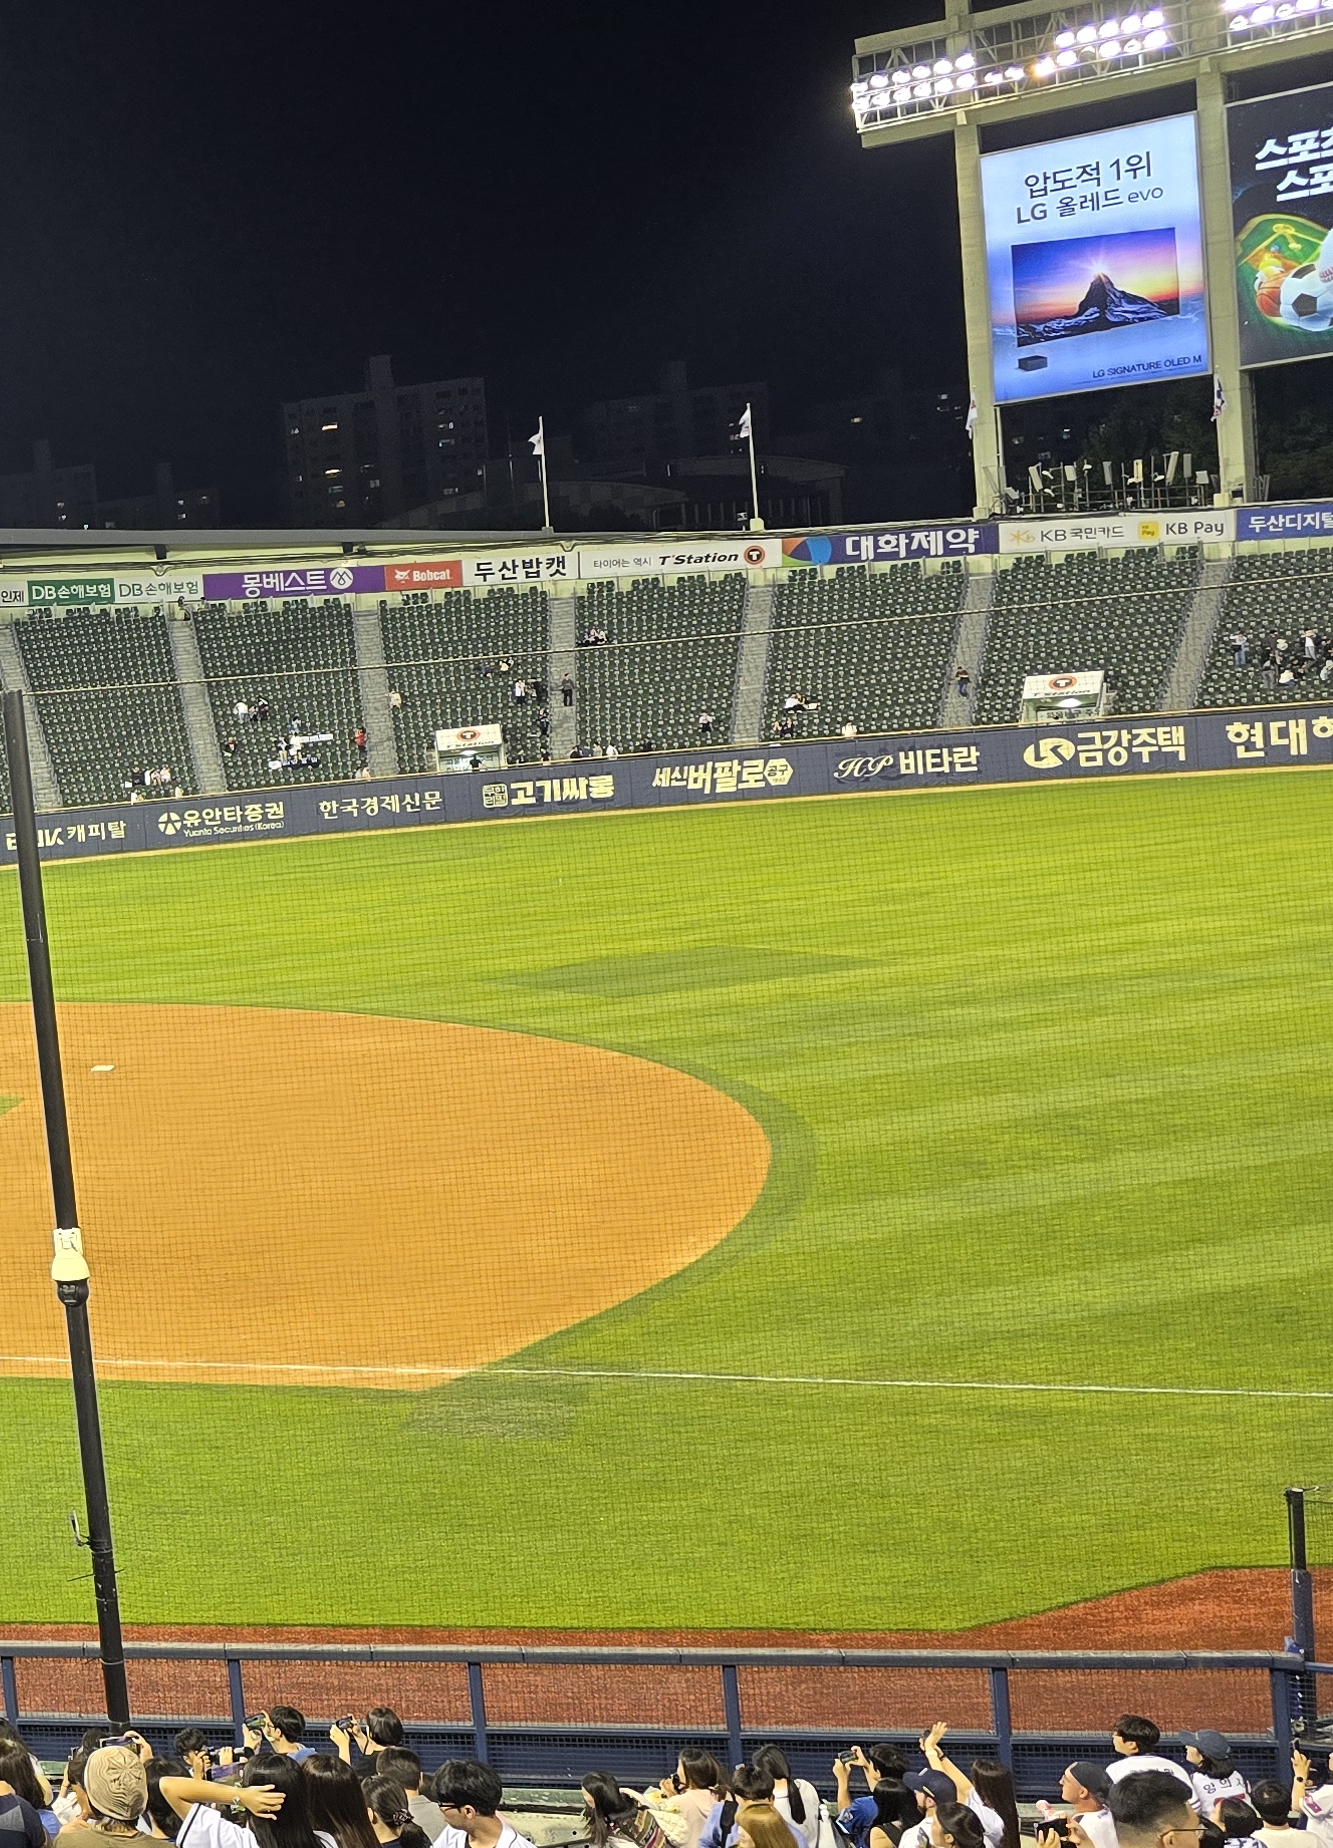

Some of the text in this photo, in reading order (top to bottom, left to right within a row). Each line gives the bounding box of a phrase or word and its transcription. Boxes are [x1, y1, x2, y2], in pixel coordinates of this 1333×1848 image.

[1024, 151, 1152, 199] 압도적 1위
[1016, 186, 1164, 224] LG 올레드 evo
[1092, 368, 1106, 379] LG
[1107, 360, 1162, 377] SIGNATURE
[1164, 356, 1190, 370] OLED
[1192, 355, 1202, 365] M
[1040, 525, 1124, 542] KB 국민카드
[1165, 520, 1224, 537] KB Pay
[845, 528, 979, 561] 대화제약
[413, 568, 452, 582] Bobcat
[474, 555, 567, 583] 두산밥캣
[593, 557, 630, 569] 타이어는
[633, 556, 652, 567] 역시
[2, 590, 24, 603] 인제
[31, 583, 111, 600] DB손해보험
[119, 580, 199, 597] DB손해보험
[241, 570, 328, 598] 몽베스트
[1076, 725, 1186, 767] 금강주택
[899, 746, 980, 774] 비타란
[509, 774, 614, 805] 고기싸롱
[183, 802, 285, 827] 유안타증권
[318, 790, 443, 820] 한국경제신문
[66, 820, 127, 842] 캐피탈
